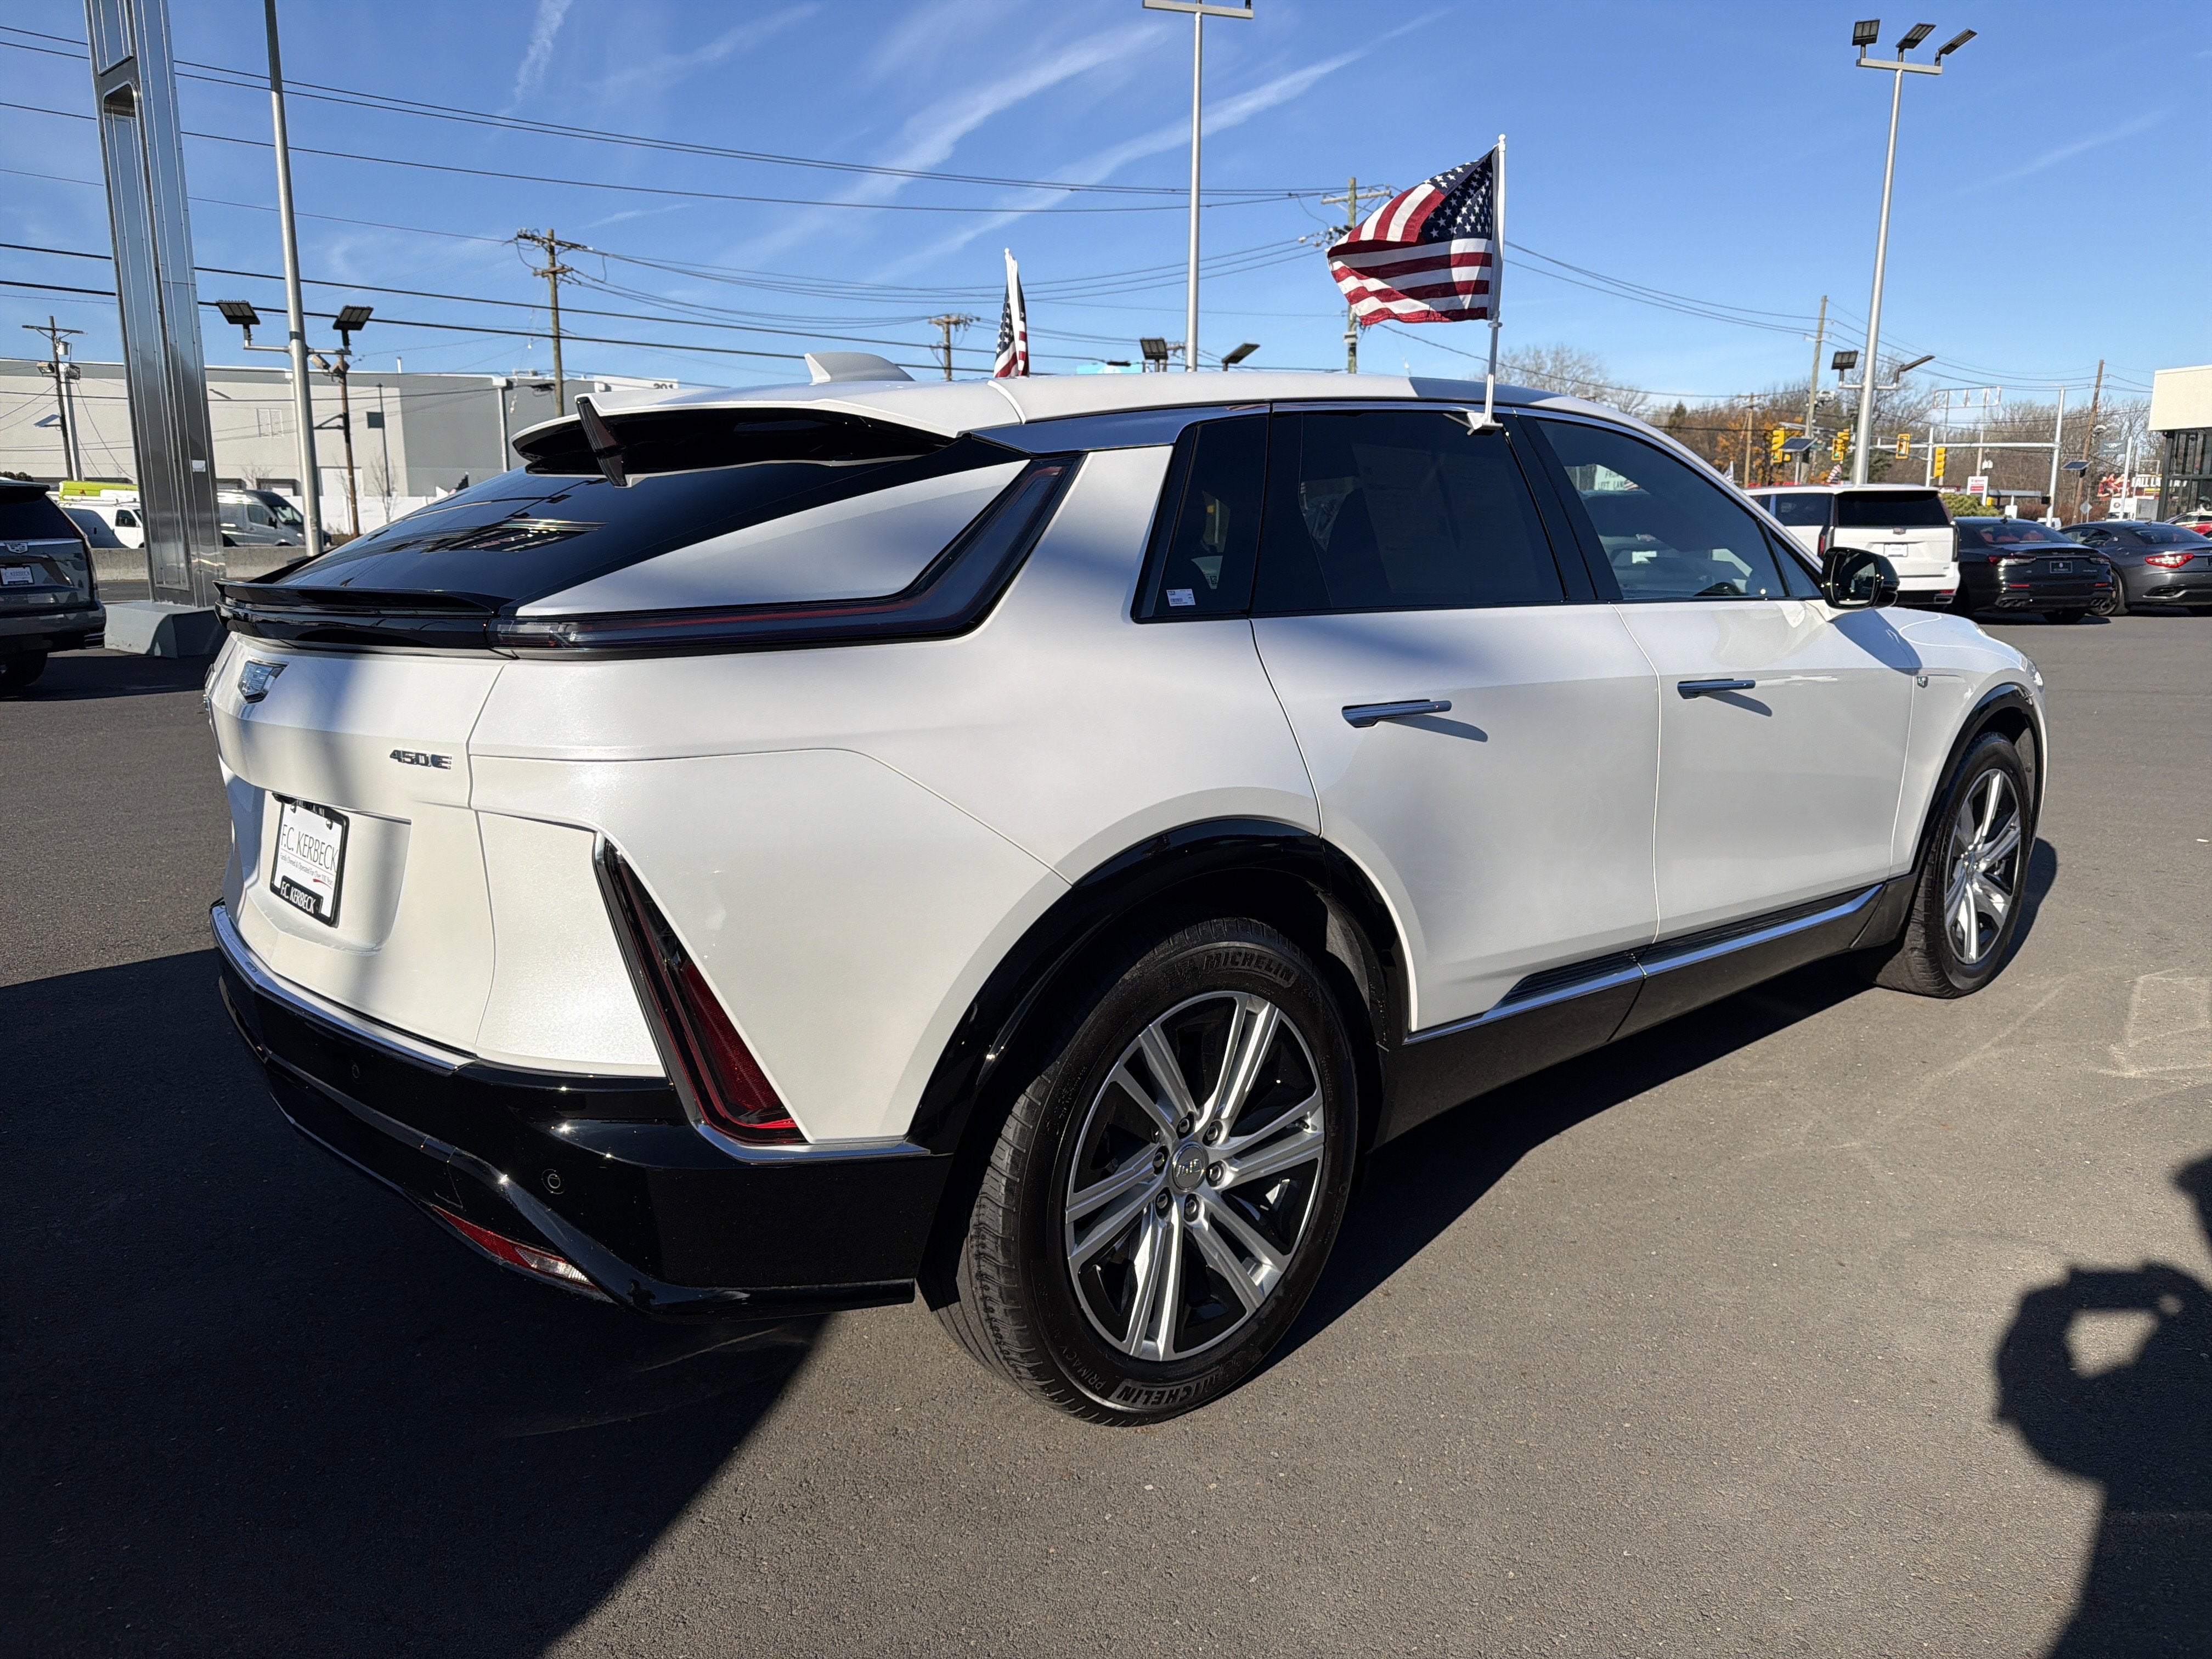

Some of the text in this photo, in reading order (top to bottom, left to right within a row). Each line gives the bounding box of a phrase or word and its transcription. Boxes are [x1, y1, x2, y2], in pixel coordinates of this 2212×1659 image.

[281, 824, 338, 872] F.C. KERBECK
[290, 887, 317, 914] KERBECK
[1205, 950, 1294, 983] MICHELIN
[1058, 1346, 1107, 1391] PRIMACY
[1116, 1374, 1216, 1406] MICHELIN
